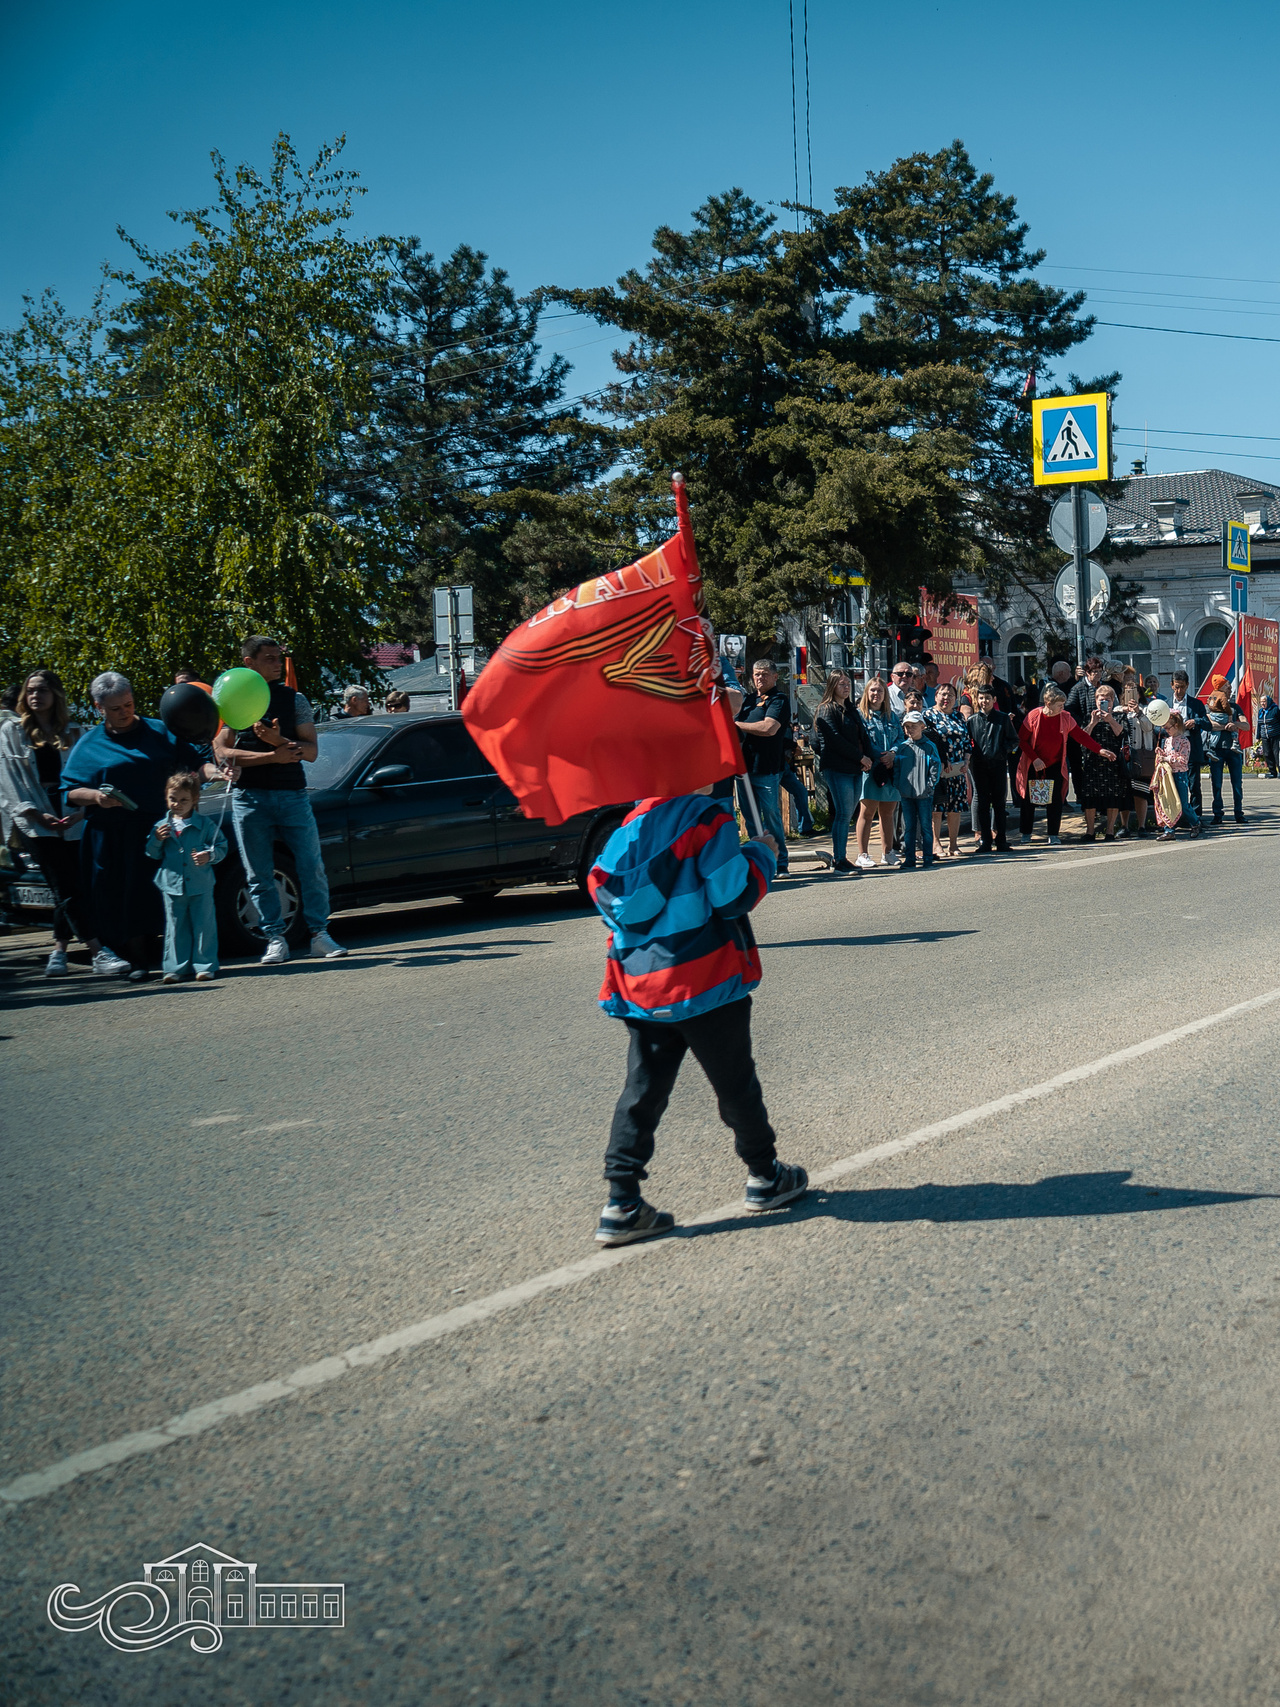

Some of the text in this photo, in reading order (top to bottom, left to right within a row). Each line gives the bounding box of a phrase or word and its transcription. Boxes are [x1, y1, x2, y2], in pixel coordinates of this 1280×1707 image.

[933, 627, 970, 640] ПОМНИМ,
[927, 640, 976, 653] НЕ ЗАБУДЕМ
[933, 654, 971, 666] НИКОГДА!
